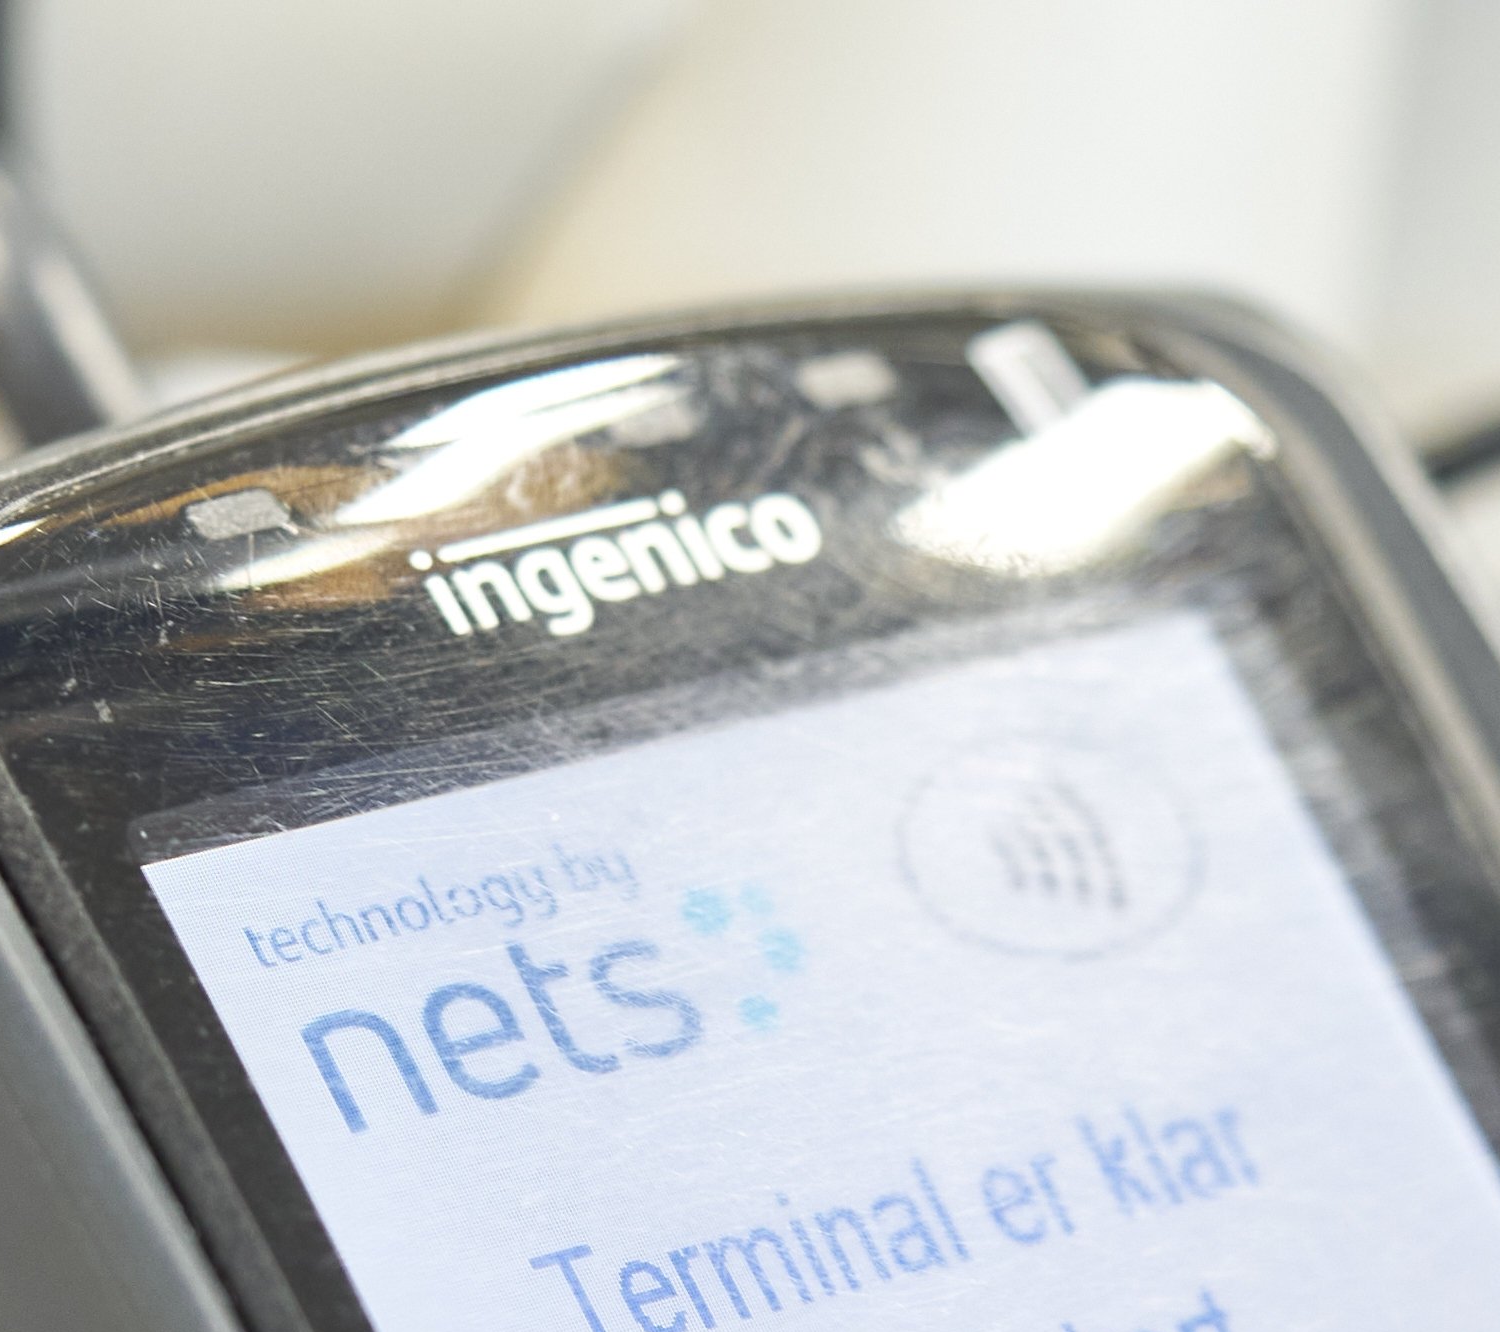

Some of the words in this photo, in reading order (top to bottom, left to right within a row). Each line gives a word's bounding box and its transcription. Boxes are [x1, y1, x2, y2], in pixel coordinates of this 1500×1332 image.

[409, 488, 822, 637] ingenico
[243, 861, 559, 968] technology
[553, 844, 640, 902] by
[301, 938, 701, 1133] nets
[984, 1152, 1076, 1246] er
[1074, 1101, 1264, 1218] klar
